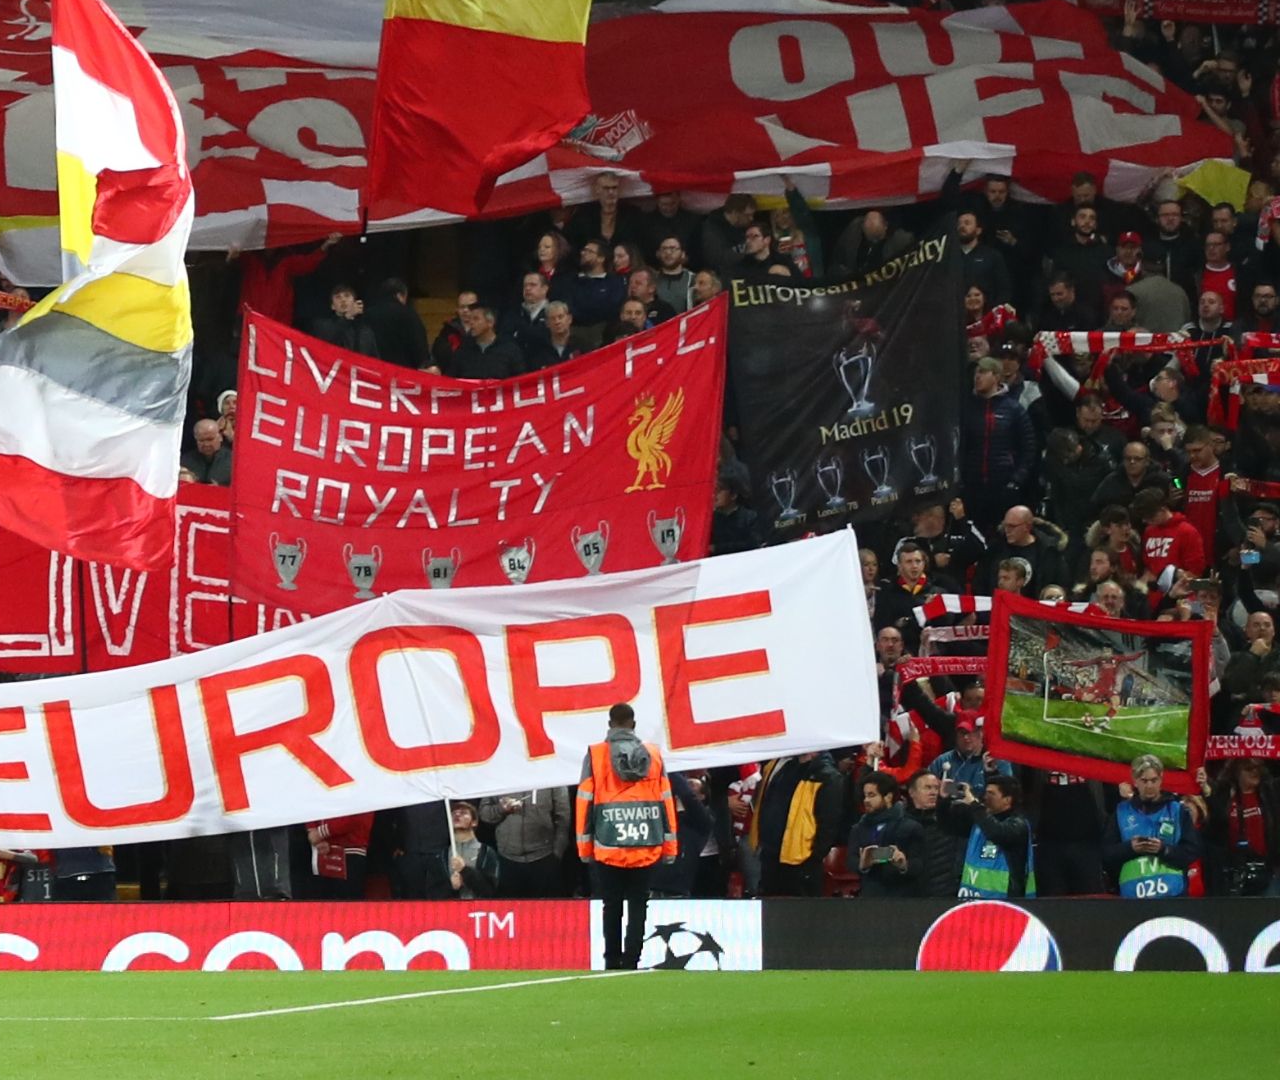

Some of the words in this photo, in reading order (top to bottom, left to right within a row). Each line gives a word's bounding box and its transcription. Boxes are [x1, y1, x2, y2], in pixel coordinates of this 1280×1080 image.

[246, 324, 586, 415] LIVERPOOL
[251, 391, 596, 473] EUROPEAN
[820, 415, 890, 446] Madrid
[893, 403, 915, 426] 19
[271, 469, 563, 530] ROYALTY
[661, 529, 676, 543] 19
[583, 541, 601, 557] 05
[277, 553, 298, 568] 77
[507, 556, 527, 572] 84
[353, 564, 372, 578] 78
[432, 566, 449, 580] 81
[1206, 734, 1270, 749] VERPOOL
[602, 806, 660, 822] STEWARD
[614, 823, 649, 842] 349
[1137, 857, 1159, 874] TV
[1135, 879, 1169, 899] 026
[468, 910, 516, 939] TM
